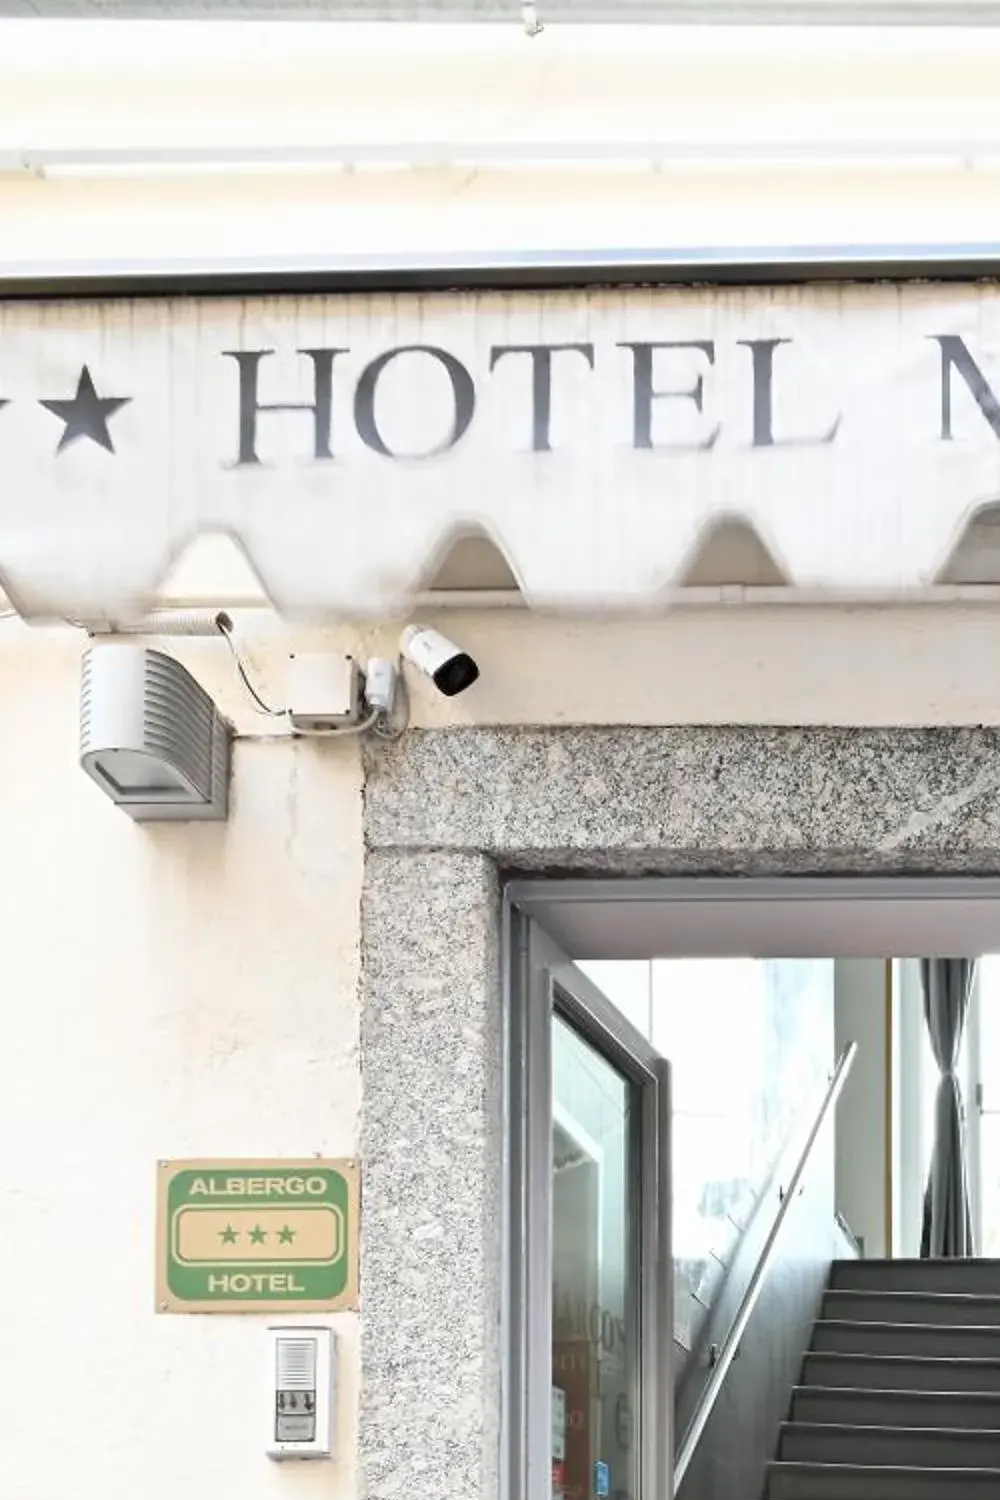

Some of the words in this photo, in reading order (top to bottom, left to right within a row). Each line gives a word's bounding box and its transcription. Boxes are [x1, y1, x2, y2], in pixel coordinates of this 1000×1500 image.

[220, 338, 842, 469] HOTEL
[188, 1175, 328, 1196] ALBERGO
[207, 1272, 305, 1294] HOTEL
